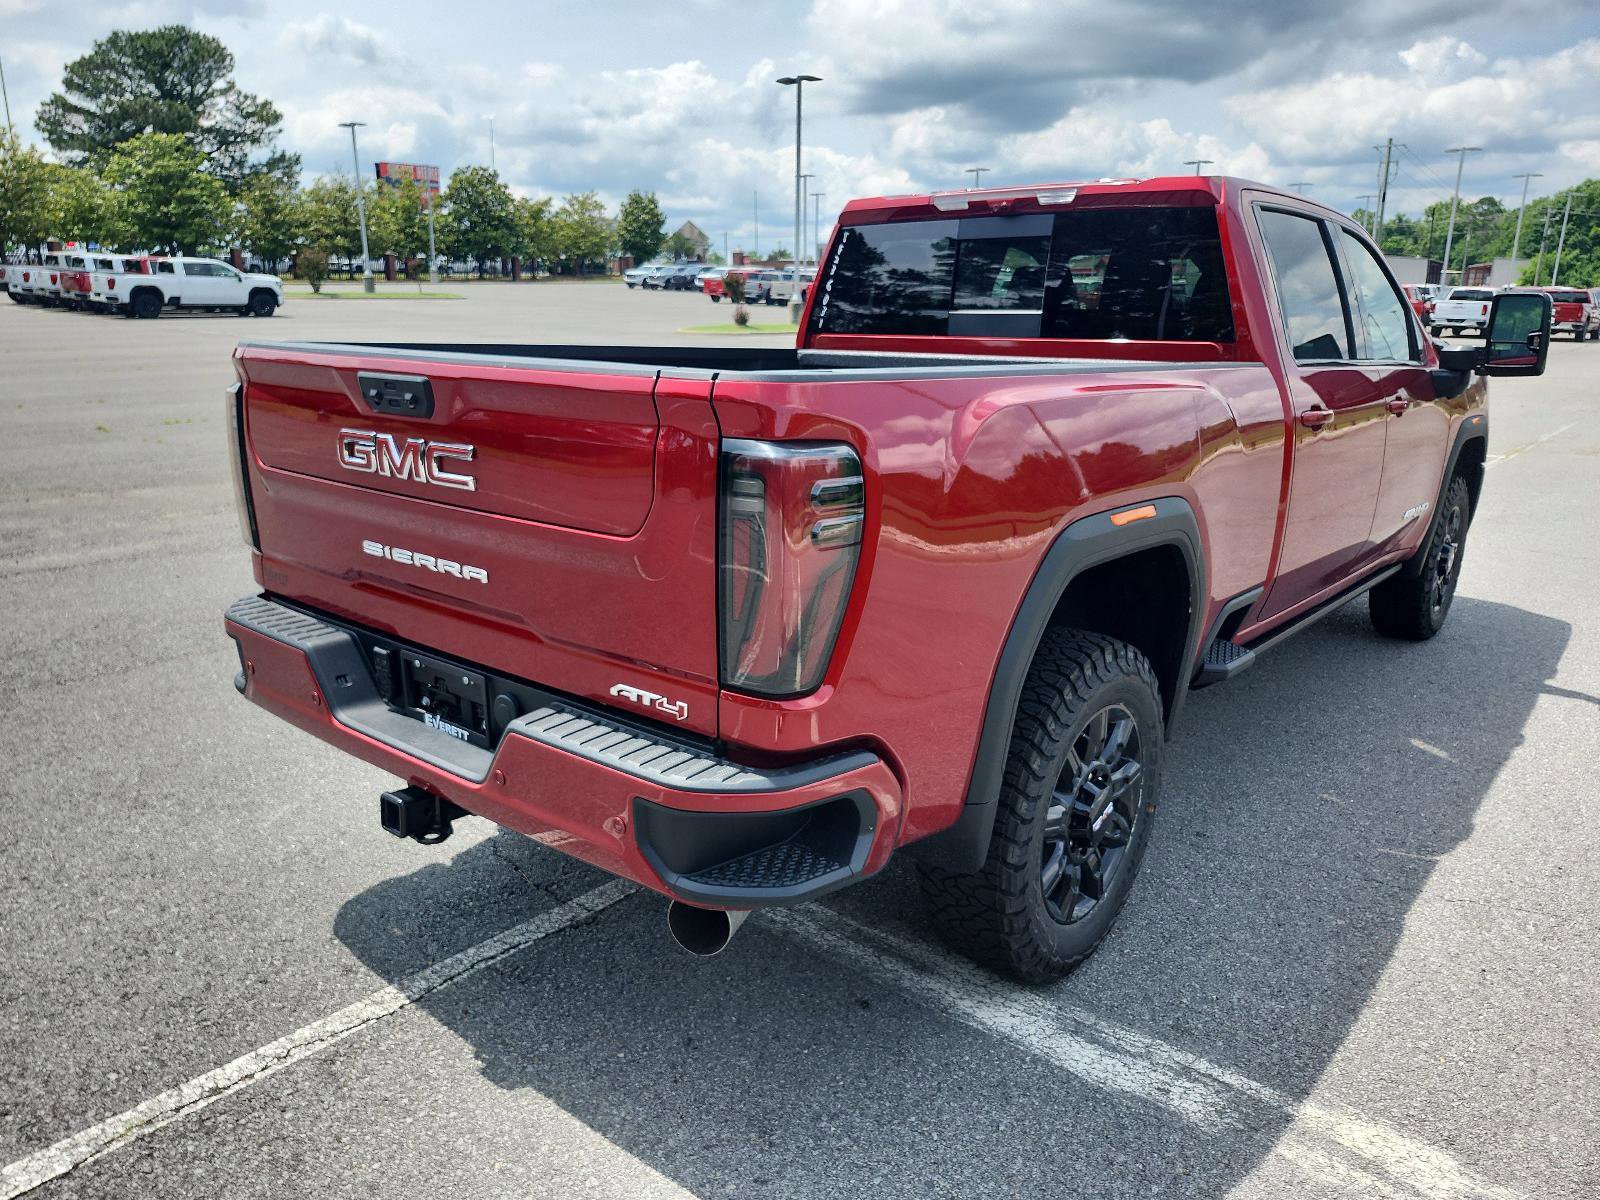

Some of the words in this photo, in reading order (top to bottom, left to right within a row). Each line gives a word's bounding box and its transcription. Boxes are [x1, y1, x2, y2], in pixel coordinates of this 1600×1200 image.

[337, 428, 477, 491] GMC
[362, 539, 489, 584] SIERRA
[610, 683, 688, 720] AT4
[424, 713, 469, 741] EVERETT
